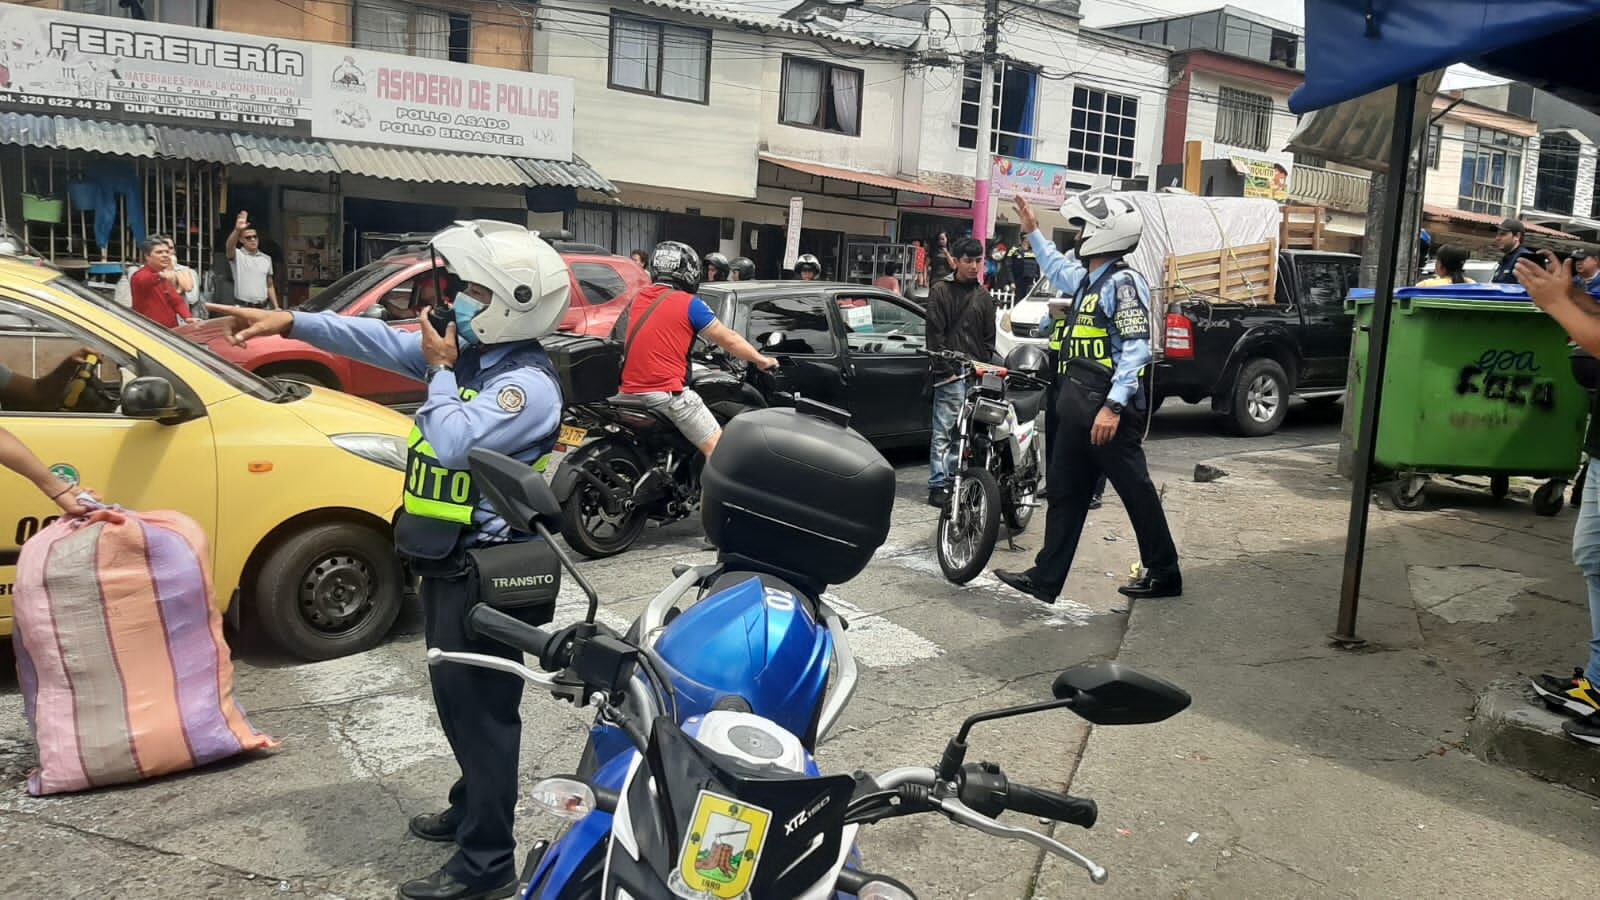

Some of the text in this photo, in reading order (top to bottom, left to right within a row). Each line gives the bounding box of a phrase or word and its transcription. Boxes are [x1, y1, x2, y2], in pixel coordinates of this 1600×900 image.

[49, 22, 303, 77] FERRETERÍA
[124, 71, 185, 86] MATERIALES
[19, 95, 44, 105] 320
[48, 98, 72, 108] 622
[75, 100, 92, 109] 44
[95, 102, 111, 111] 29
[377, 68, 559, 119] ASADERO DE POLLOS
[124, 103, 295, 127] DUPLICADOS DE LLAVES
[396, 107, 510, 130] POLLO ASADO
[379, 121, 436, 137] POLLO
[439, 126, 525, 146] BROASTER
[491, 574, 554, 588] TRANSITO
[784, 810, 808, 836] XTZ
